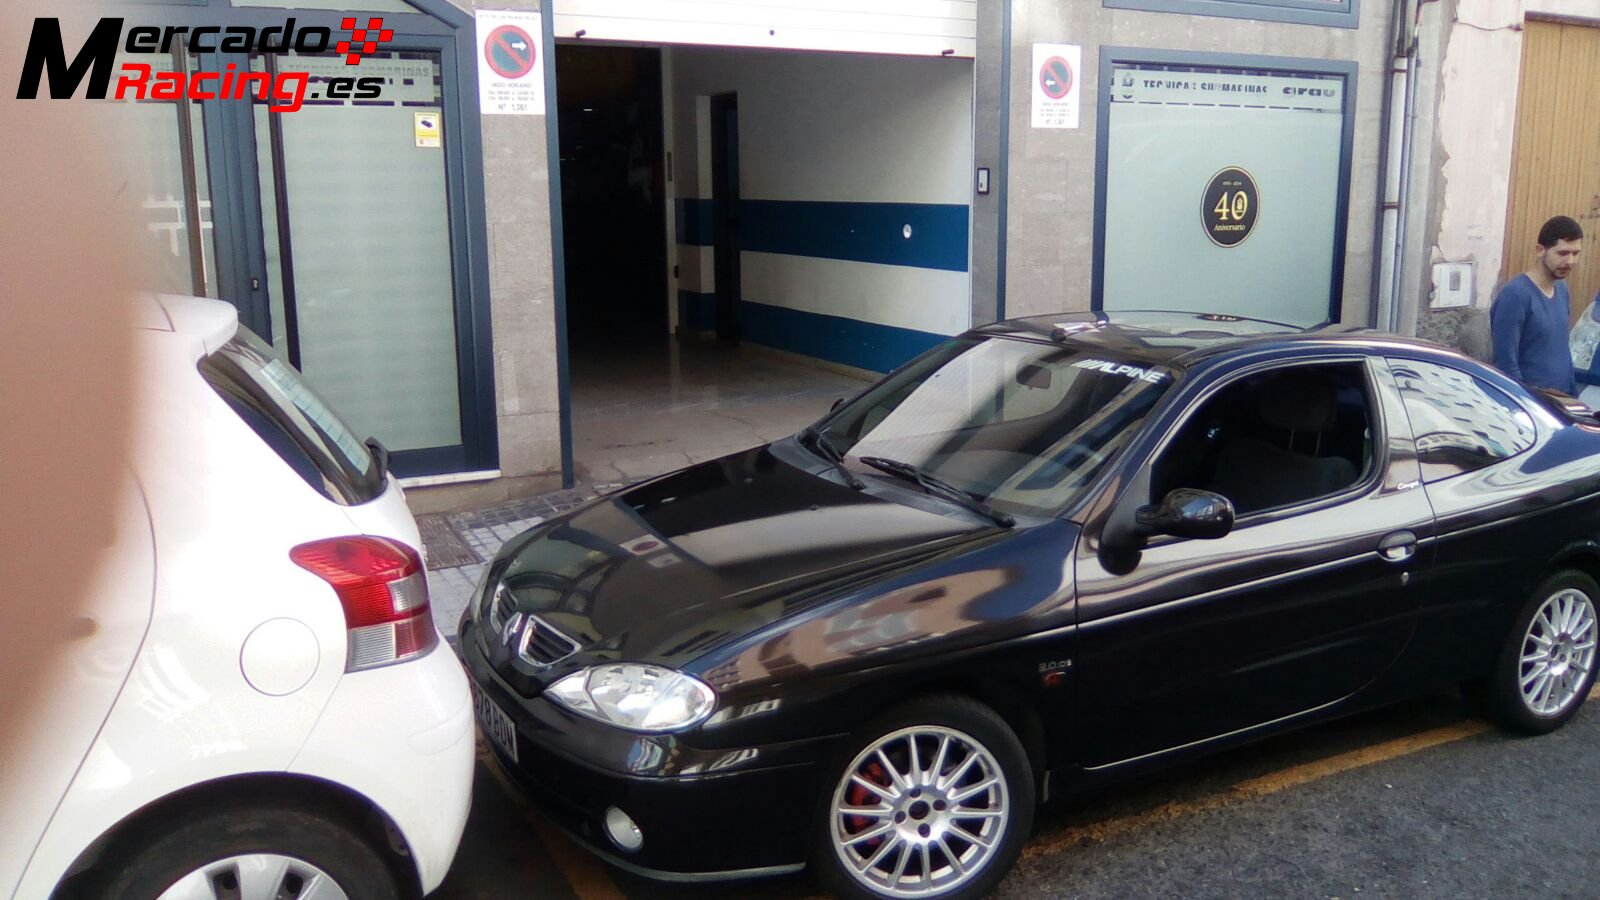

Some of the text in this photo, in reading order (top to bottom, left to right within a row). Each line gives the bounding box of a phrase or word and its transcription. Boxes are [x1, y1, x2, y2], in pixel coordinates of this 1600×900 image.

[1200, 82, 1268, 93] SUMARINAS
[1213, 190, 1249, 221] 40
[1213, 223, 1246, 232] Aniversario
[1098, 361, 1166, 384] ALPINE
